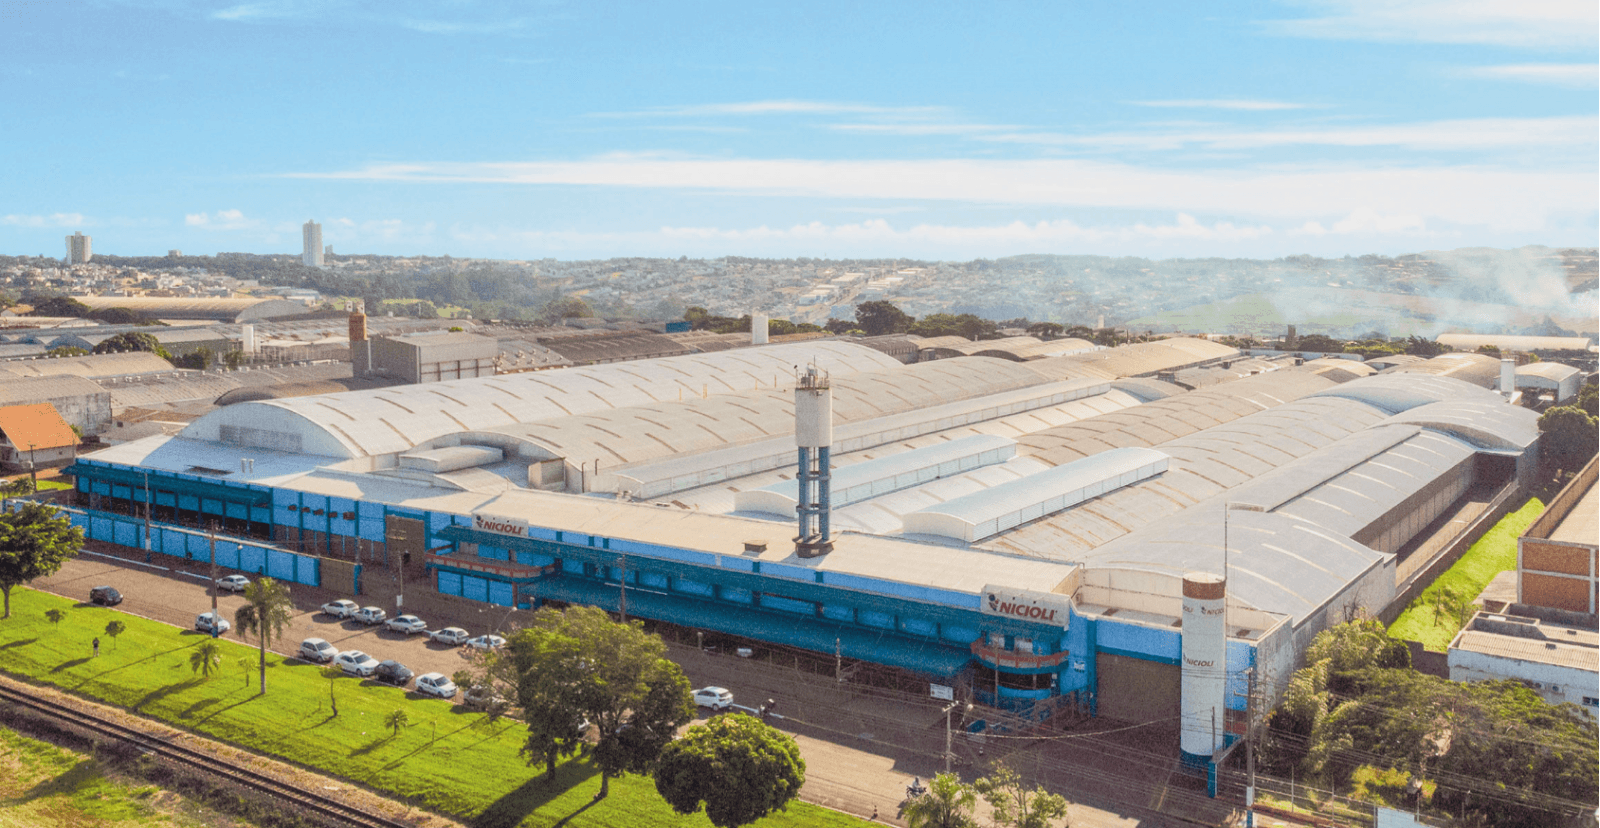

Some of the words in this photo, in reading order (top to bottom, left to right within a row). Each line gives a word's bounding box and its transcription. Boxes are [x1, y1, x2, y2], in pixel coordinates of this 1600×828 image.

[484, 521, 522, 534] NICIOLI
[1000, 602, 1055, 620] NICIOLI
[1186, 658, 1214, 667] NICIOLI
